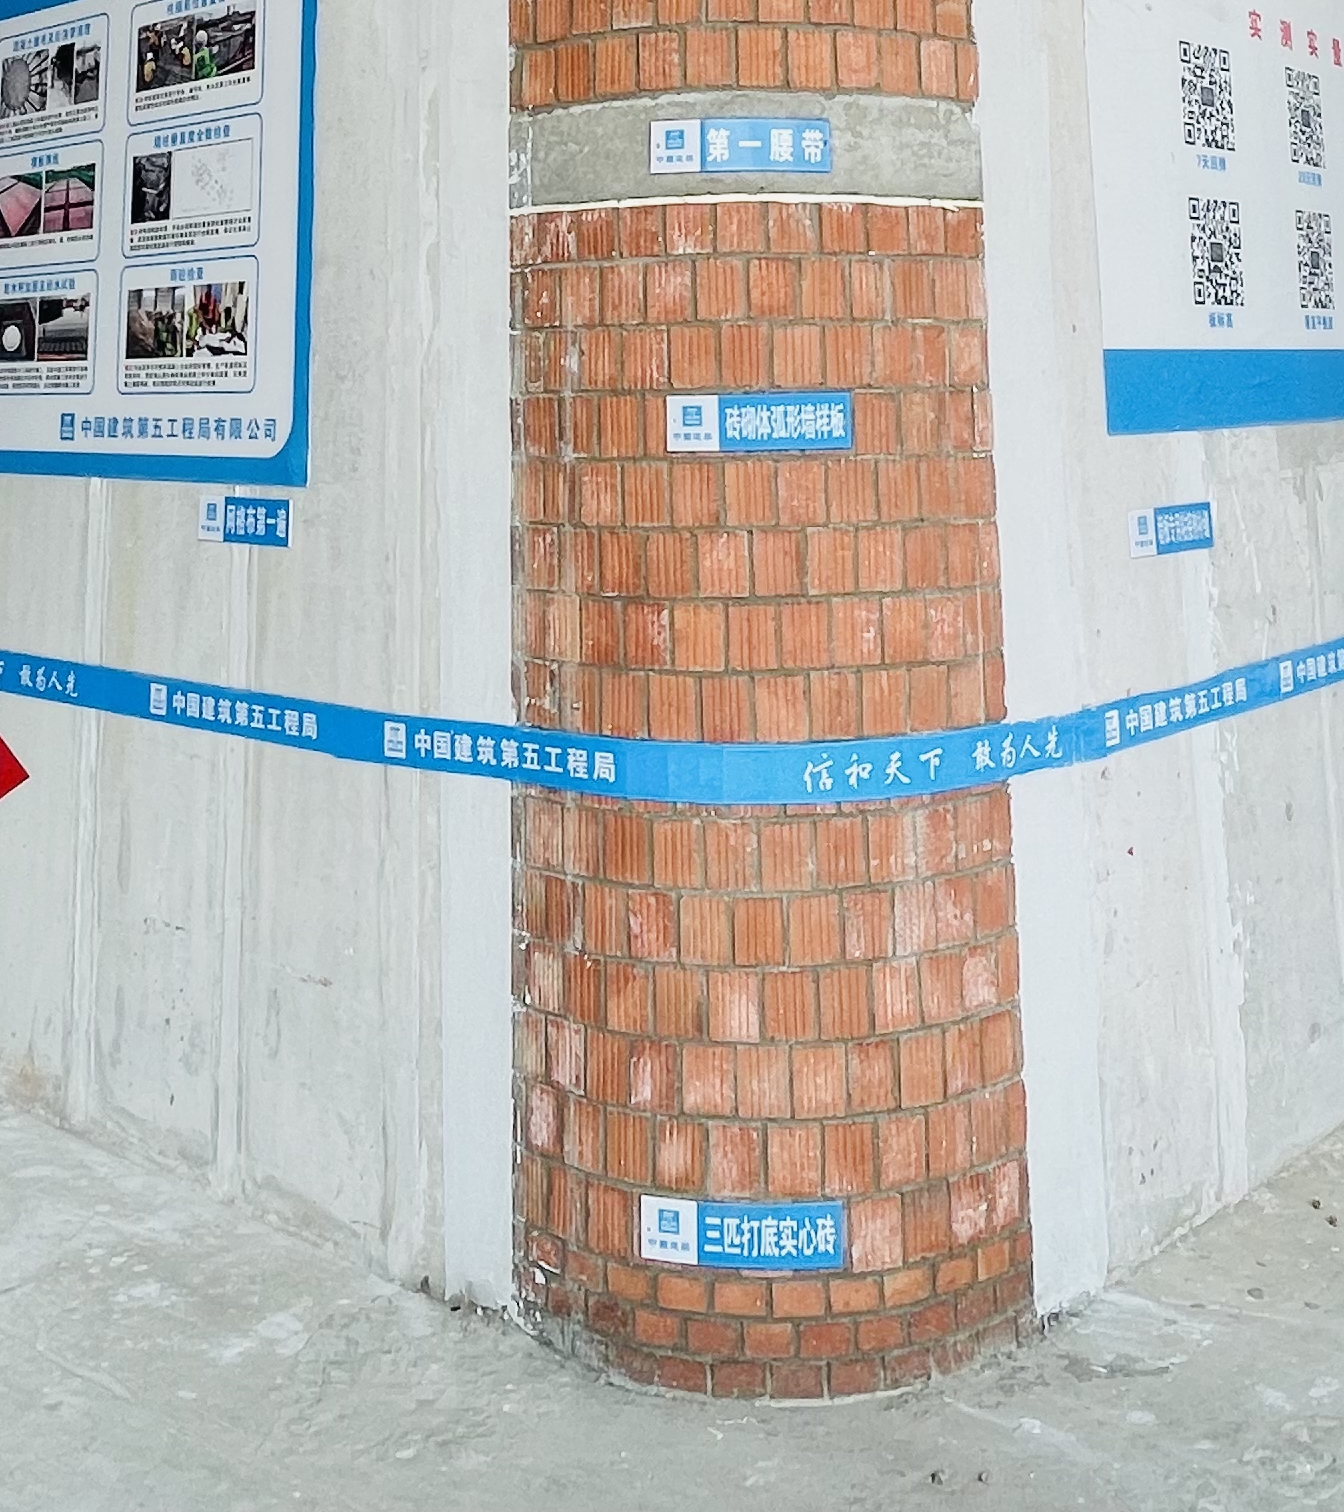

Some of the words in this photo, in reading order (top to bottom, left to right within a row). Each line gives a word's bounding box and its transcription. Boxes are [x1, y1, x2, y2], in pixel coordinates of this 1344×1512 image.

[1248, 9, 1343, 68] 实测实量
[706, 127, 824, 164] 第一腰带
[81, 416, 277, 442] 中国建筑第五工程局有限公司
[226, 504, 287, 538] 网格布第一遍
[172, 689, 318, 741] 中国建筑第五工程局
[1125, 677, 1247, 737] 中国建筑第五工程局
[413, 728, 617, 784] 中国建筑第五工程局
[803, 747, 944, 794] 信和天下
[971, 725, 1063, 774] 敢为人先
[703, 1214, 837, 1258] 三匹打底实心砖
